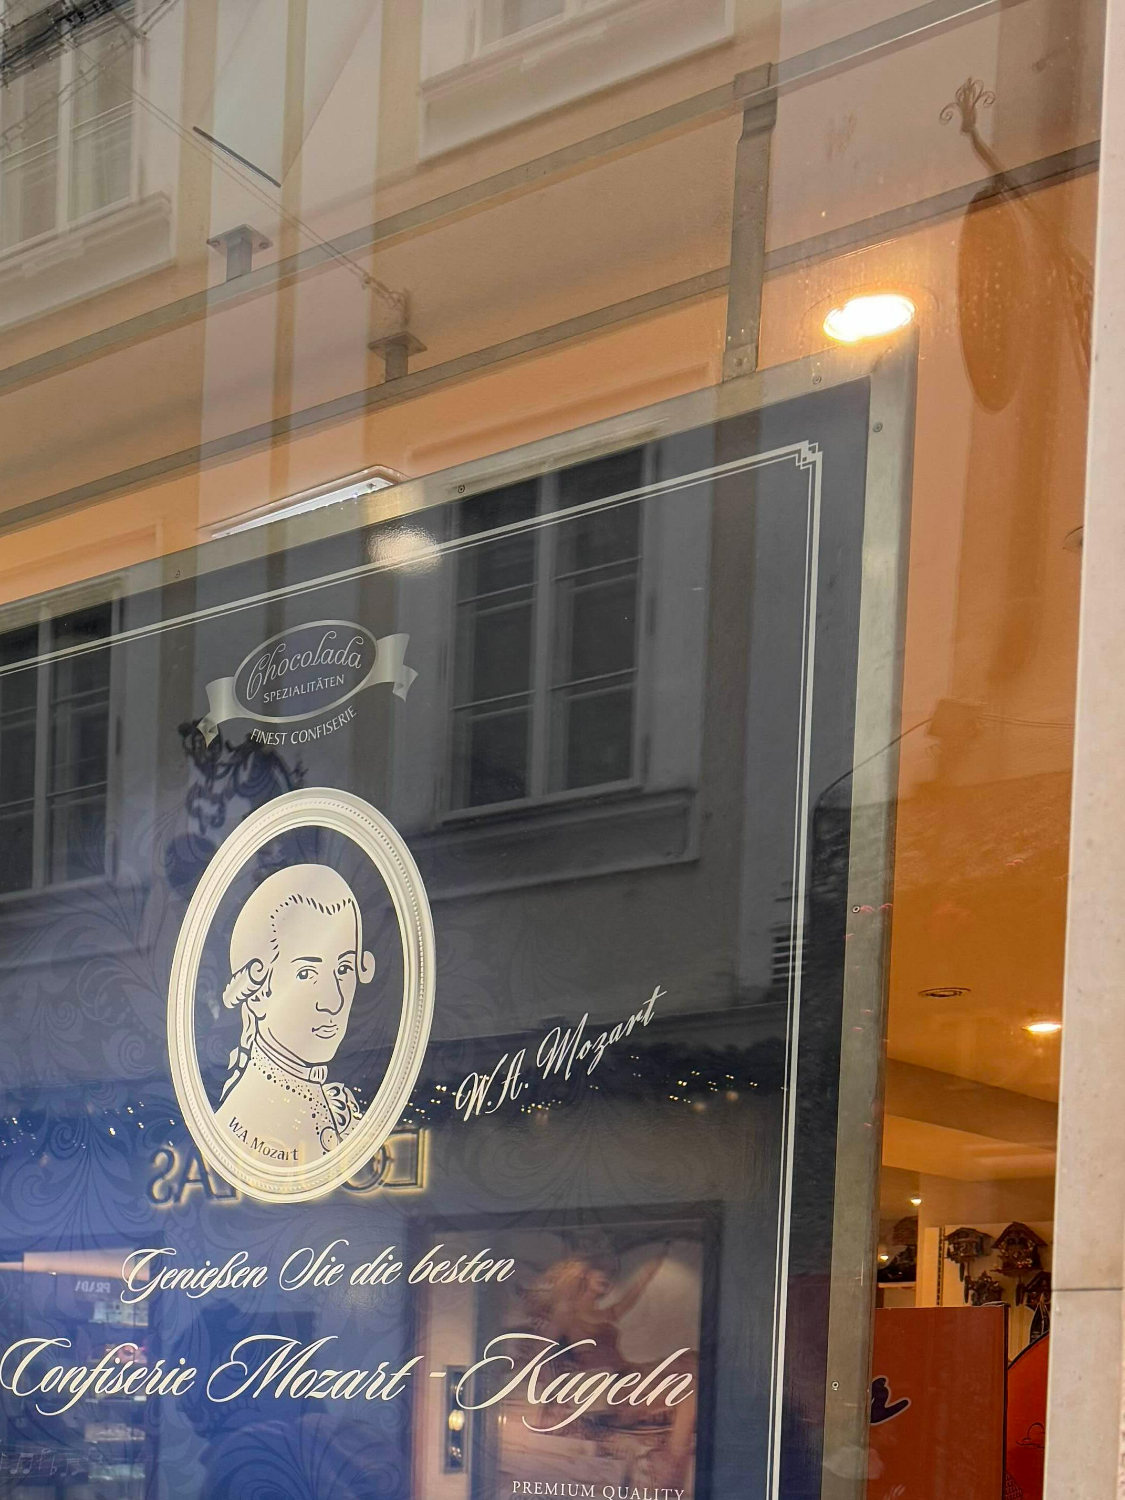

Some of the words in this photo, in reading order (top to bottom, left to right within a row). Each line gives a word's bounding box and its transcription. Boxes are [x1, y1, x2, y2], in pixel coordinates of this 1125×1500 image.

[245, 630, 365, 701] Chocolada
[263, 674, 345, 703] SPEZIALITÄTEN
[249, 727, 286, 746] FINEST
[290, 705, 358, 745] CONFISERIE
[536, 985, 668, 1082] Mozart
[250, 1137, 299, 1161] Mozart
[120, 1248, 267, 1304] Genießen
[278, 1239, 349, 1294] Sie
[349, 1244, 401, 1286] die
[408, 1243, 515, 1285] besten
[0, 1337, 197, 1416] Confiserie
[206, 1333, 425, 1403] Mozart
[456, 1332, 698, 1431] Kugeln
[512, 1480, 595, 1499] PREMIUM
